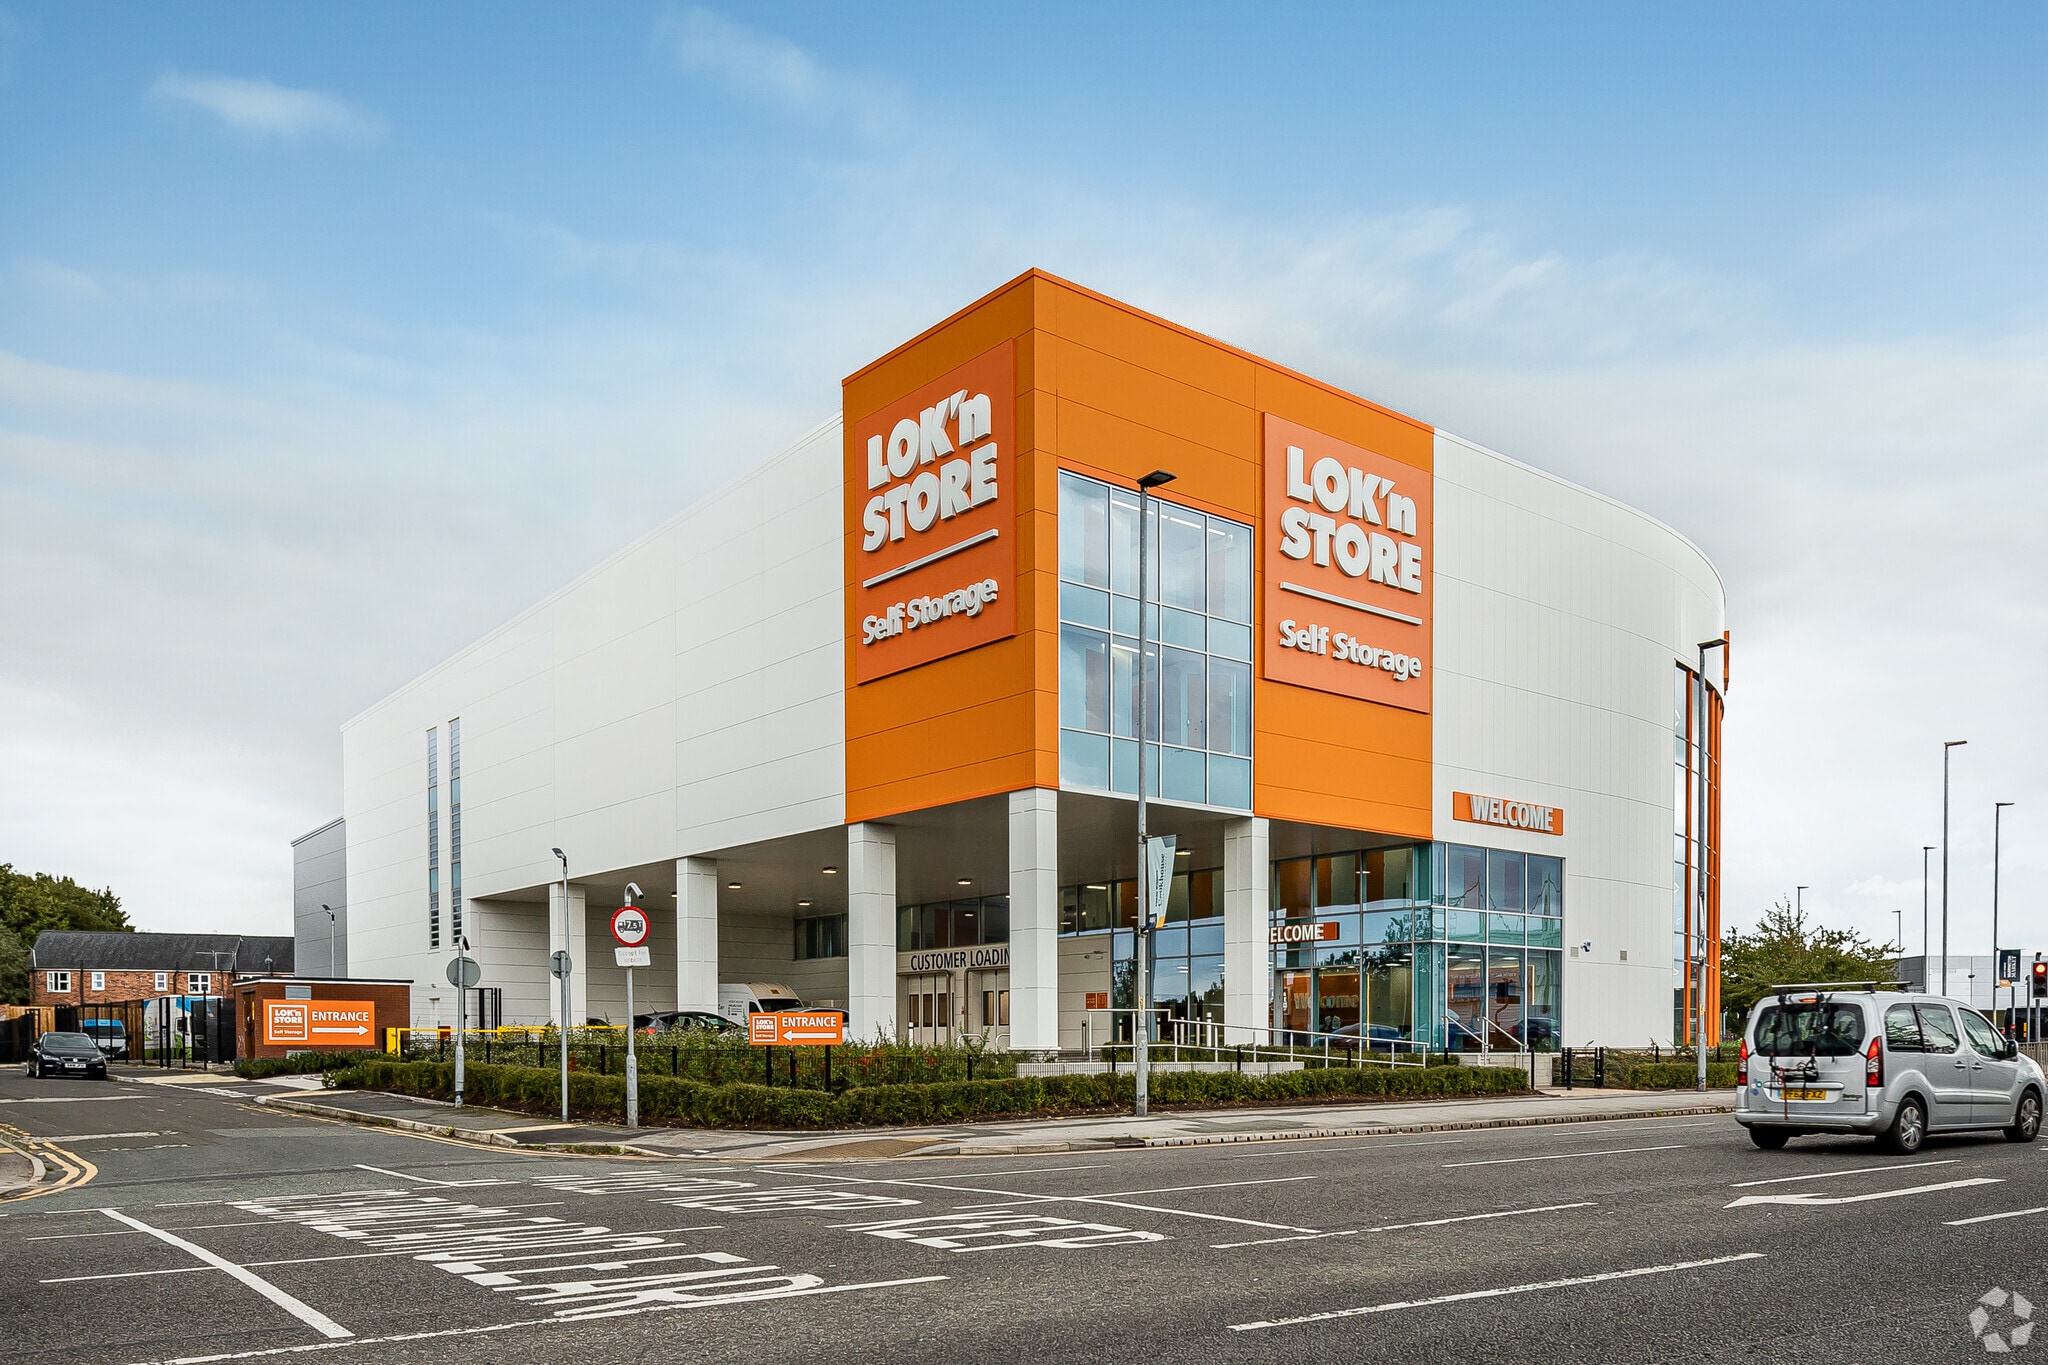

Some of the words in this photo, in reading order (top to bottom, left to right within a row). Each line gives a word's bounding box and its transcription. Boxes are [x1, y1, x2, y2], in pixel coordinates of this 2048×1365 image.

[868, 389, 991, 490] LOK'n
[863, 442, 998, 551] STORE
[1286, 445, 1417, 538] LOK'n
[1280, 506, 1422, 594] STORE
[863, 602, 905, 645] Self
[907, 578, 998, 630] Storage
[1279, 619, 1329, 655] Self
[1332, 632, 1422, 681] Storage
[1469, 795, 1553, 832] WELCOME
[1269, 923, 1324, 943] ELCOME
[911, 951, 967, 970] CUSTOMER
[273, 1016, 303, 1024] STORE
[274, 1009, 302, 1017] LOK'n
[311, 1011, 369, 1022] ENTRANCE
[782, 1016, 837, 1027] ENTRANCE
[825, 1210, 1168, 1253] KEEP
[411, 1235, 824, 1318] CLEAR
